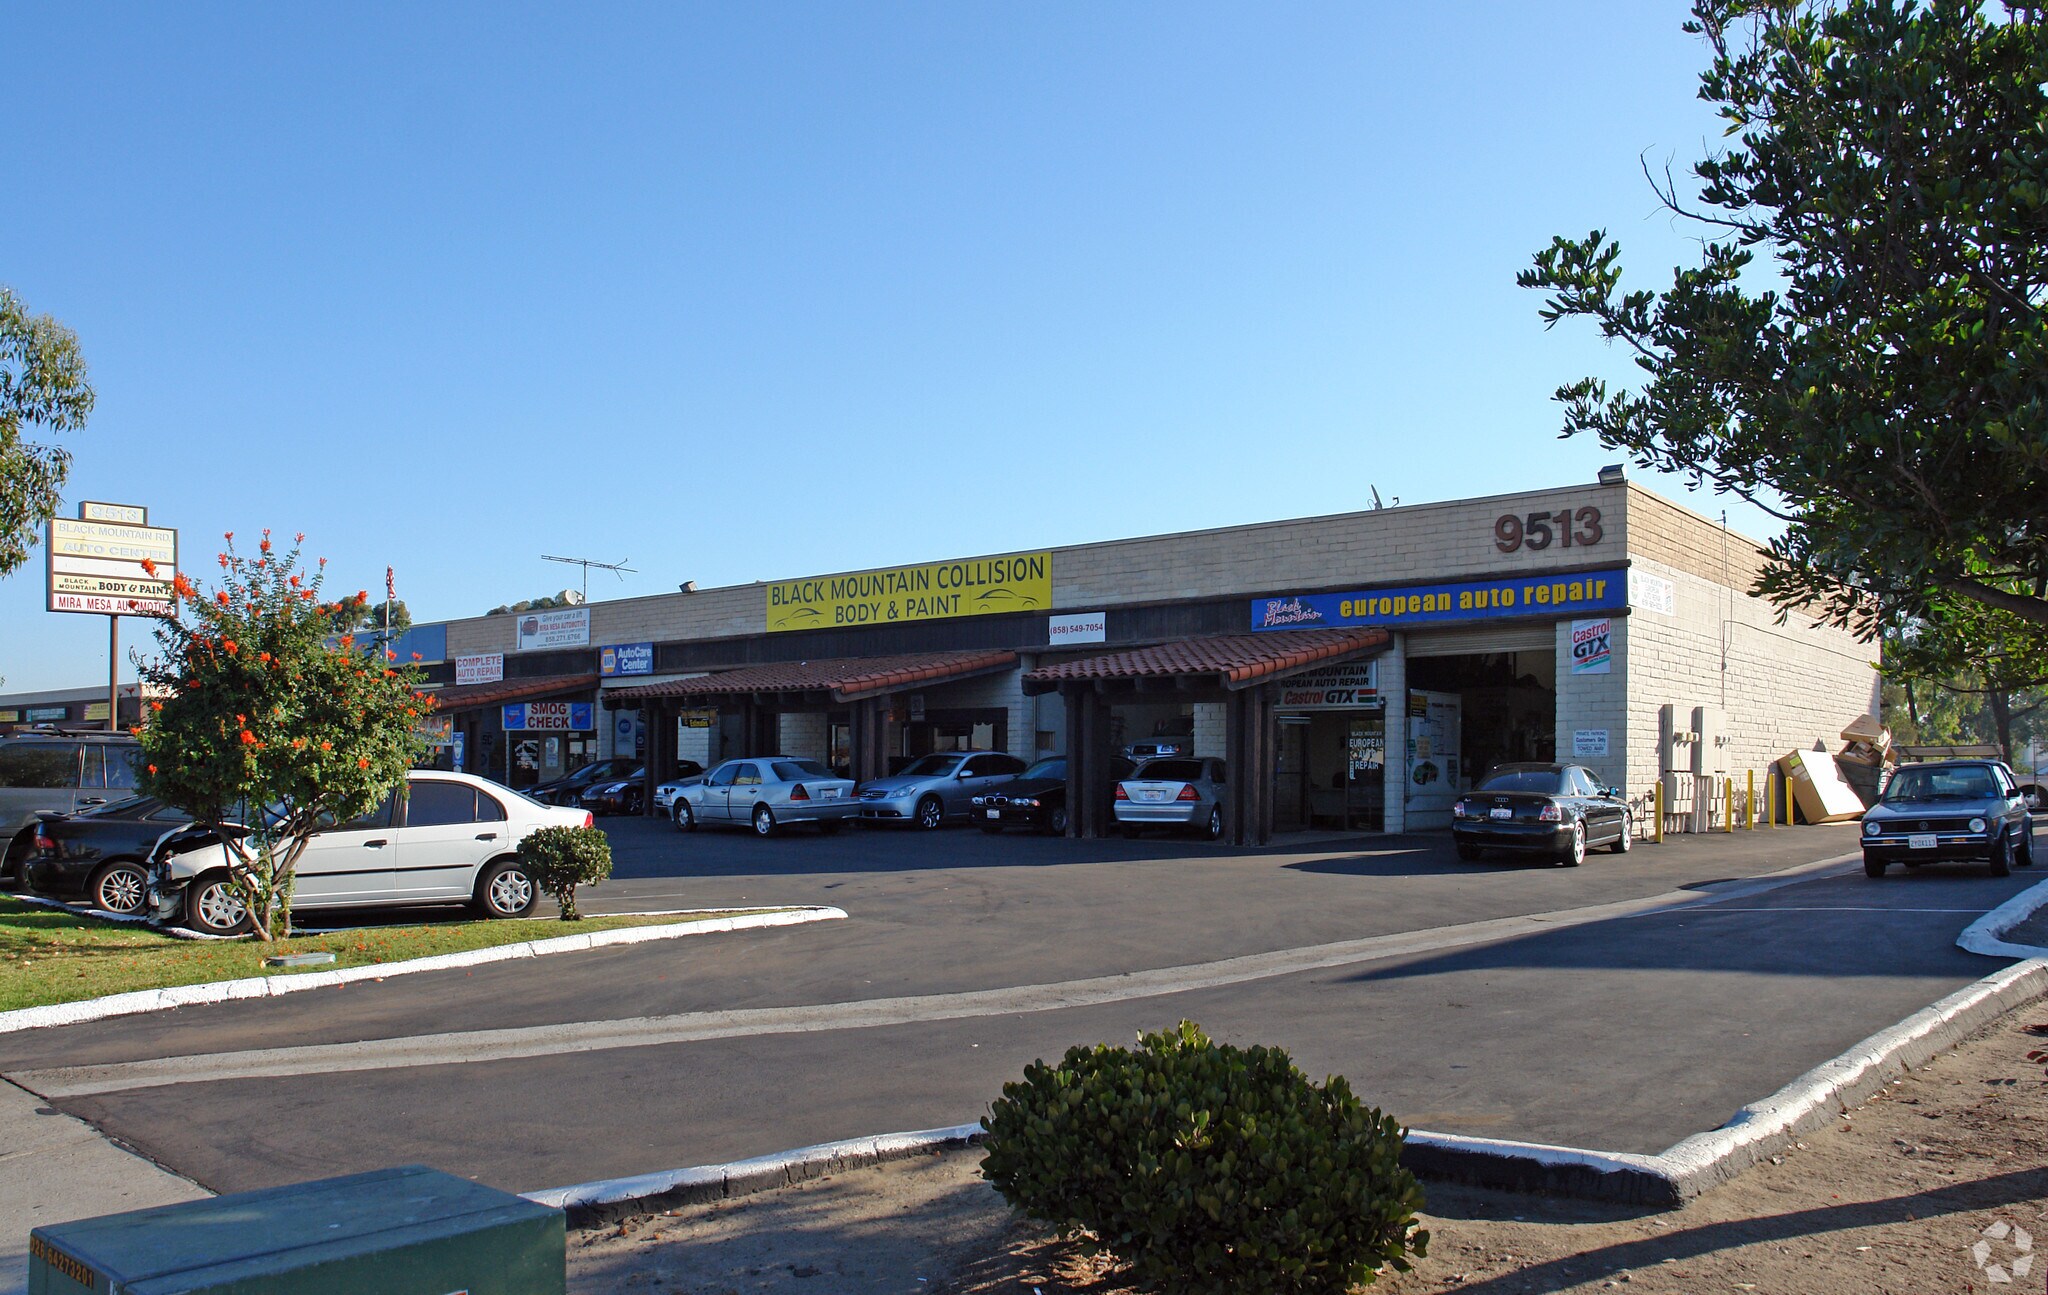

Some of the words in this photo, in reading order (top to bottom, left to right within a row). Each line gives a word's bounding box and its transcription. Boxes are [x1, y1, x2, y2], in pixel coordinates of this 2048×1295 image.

[91, 506, 139, 521] 9513
[58, 523, 95, 535] BLACK
[98, 527, 153, 540] MOUNTAIN
[155, 532, 171, 543] RD.
[1495, 506, 1603, 553] 9513
[63, 542, 105, 554] AUTO
[109, 545, 169, 560] CENTER
[58, 583, 97, 591] MOUNTAIN
[64, 577, 89, 585] BLACK
[98, 581, 127, 592] BODY
[128, 583, 138, 593] &
[772, 581, 825, 606] BLACK
[831, 566, 929, 600] MOUNTAIN
[937, 556, 1044, 589] COLLISION
[58, 596, 82, 609] MIRA
[86, 598, 112, 611] MESA
[1340, 592, 1451, 618] european
[1459, 586, 1515, 609] auto
[1523, 578, 1606, 605] repair
[835, 602, 881, 624] BODY
[887, 600, 900, 618] &
[906, 594, 961, 617] PAINT
[1267, 598, 1301, 614] Black
[1264, 607, 1322, 626] Mountain
[561, 619, 587, 629] AUTOMOTIVE
[1050, 625, 1069, 635] (858)
[1070, 623, 1103, 633] 549-7054
[1573, 619, 1610, 643] Castrol
[1574, 632, 1610, 658] GTX
[618, 646, 652, 659] AutoCare
[457, 655, 502, 668] COMPLETE
[622, 658, 648, 670] Center
[457, 668, 475, 678] AUTO
[476, 666, 502, 676] REPAIR
[1309, 665, 1368, 677] MOUNTAIN
[1314, 678, 1337, 688] AUTO
[1339, 677, 1369, 687] REPAIR
[1284, 690, 1325, 705] Castrol
[1325, 689, 1357, 704] GTX
[531, 703, 567, 715] SMOG
[527, 716, 570, 729] CHECK
[1349, 738, 1384, 748] EUROPEAN
[1358, 748, 1377, 759] AUTO
[1355, 760, 1379, 770] REPAIR
